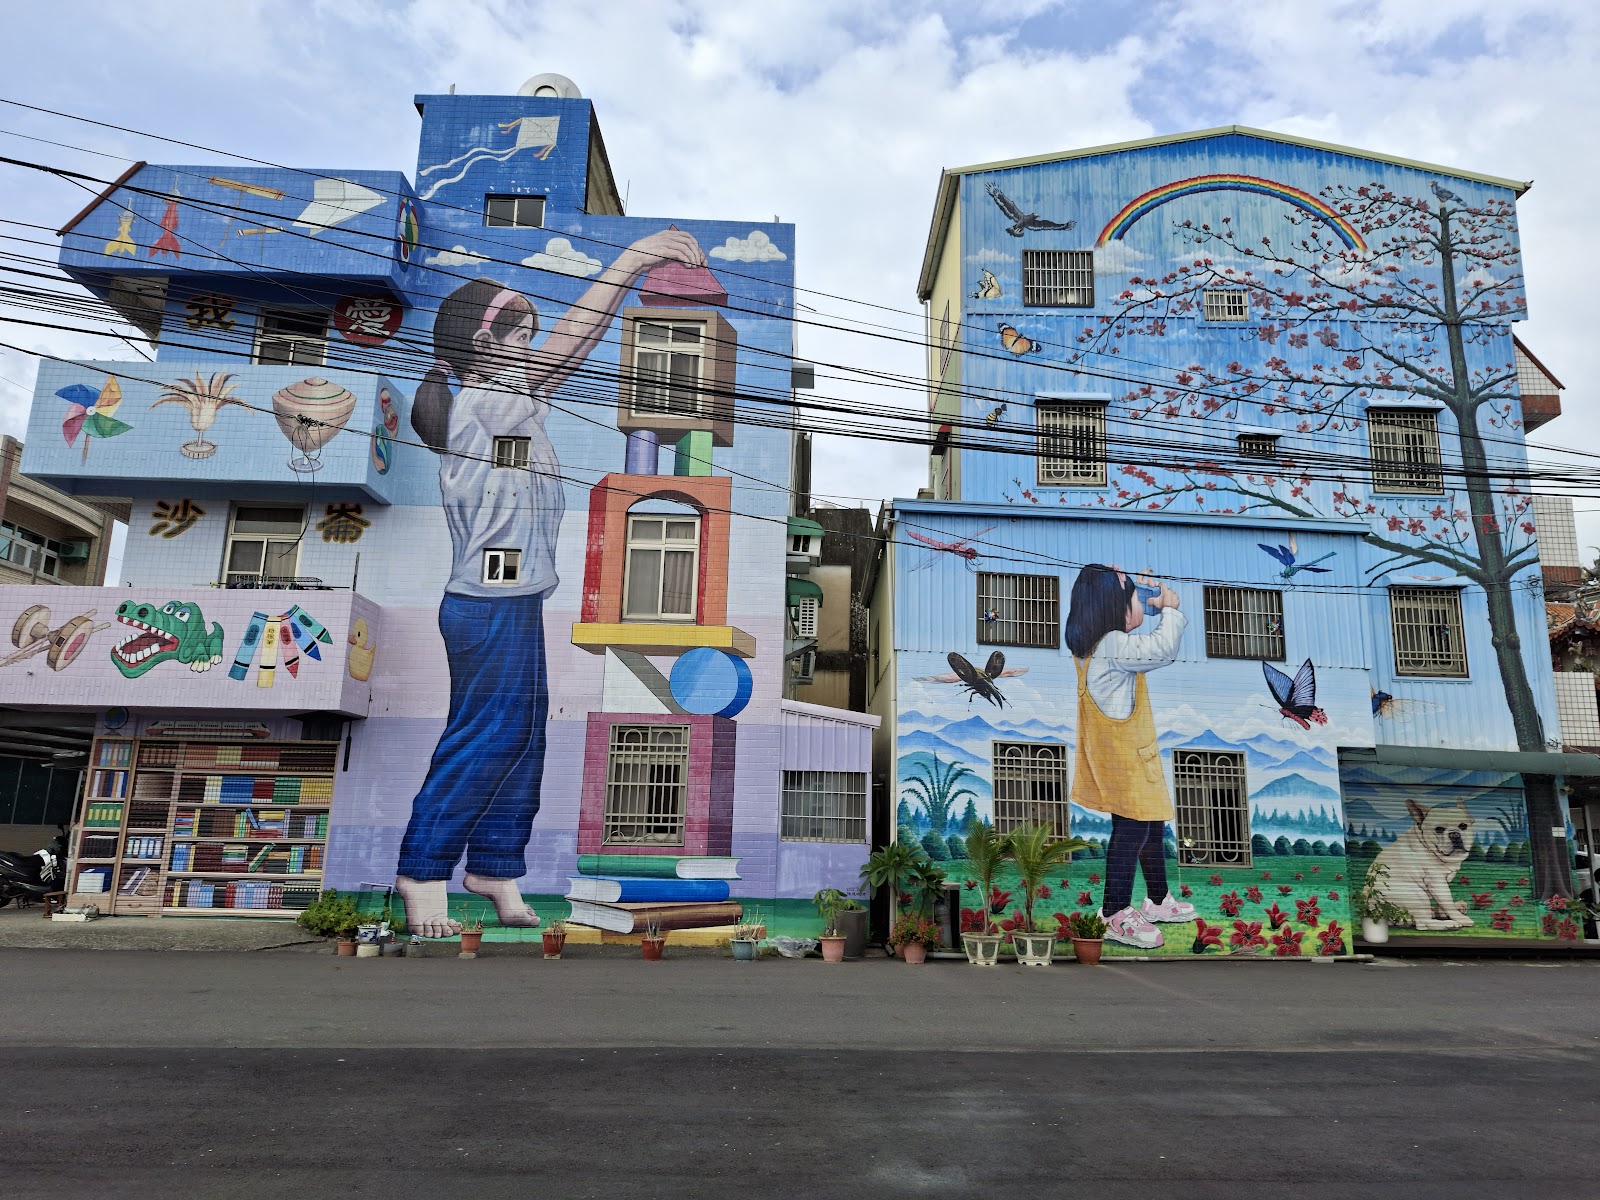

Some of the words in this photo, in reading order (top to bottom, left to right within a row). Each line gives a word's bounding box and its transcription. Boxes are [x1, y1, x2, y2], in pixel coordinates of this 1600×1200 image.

[185, 294, 236, 330] 我
[345, 298, 392, 337] 愛
[149, 499, 206, 539] 沙
[315, 502, 371, 544] 崙
